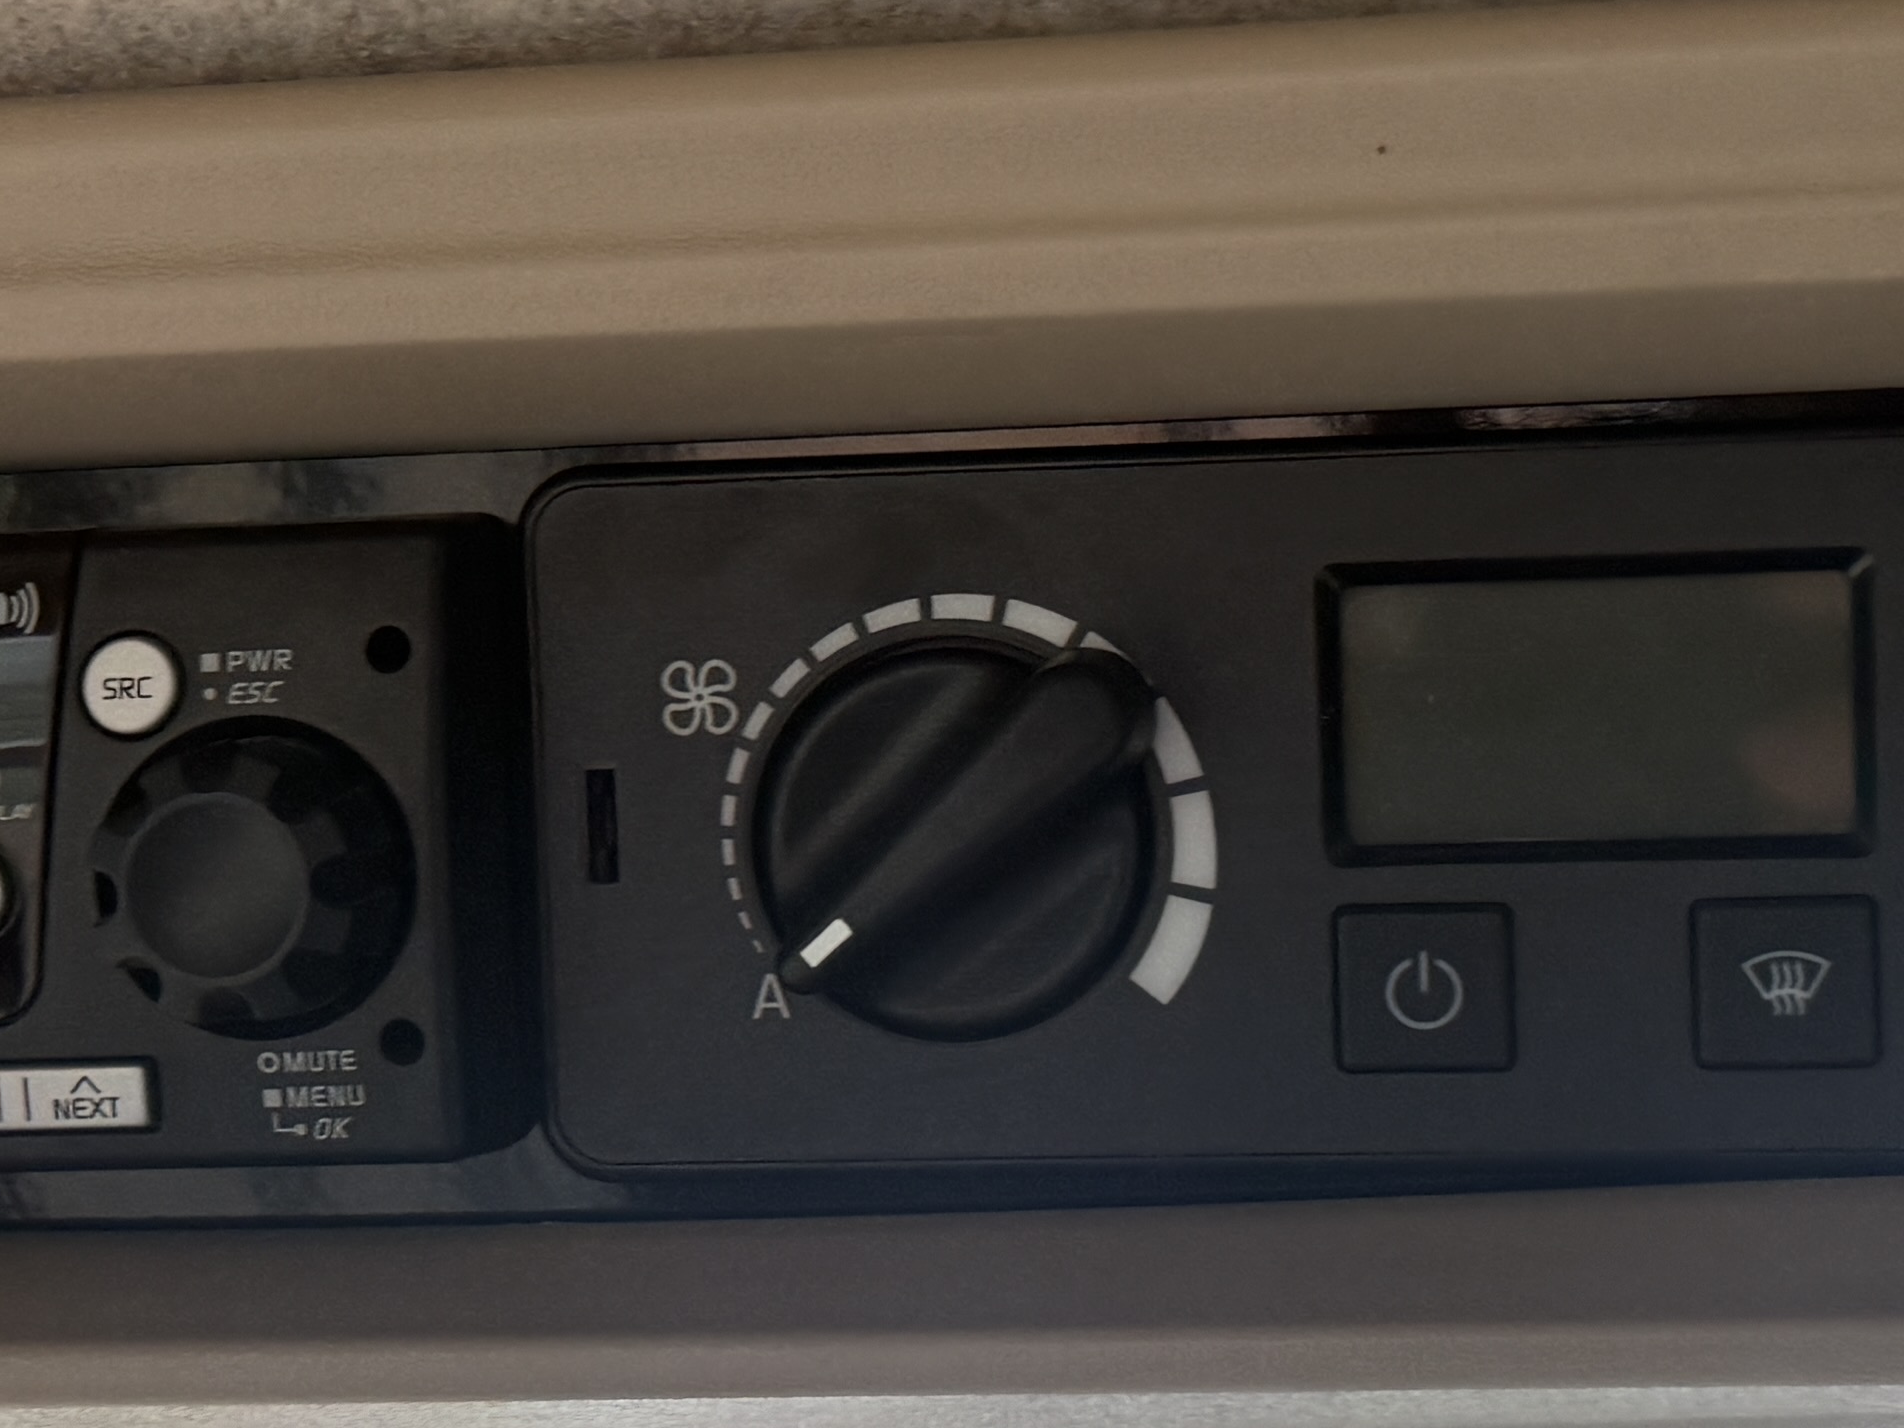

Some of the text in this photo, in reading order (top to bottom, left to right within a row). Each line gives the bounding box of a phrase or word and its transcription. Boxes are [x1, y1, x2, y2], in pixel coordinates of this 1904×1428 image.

[226, 648, 294, 673] PWR
[102, 676, 153, 700] SRC
[226, 680, 285, 705] ESC
[751, 972, 792, 1021] A
[281, 1049, 359, 1073] MUTE
[286, 1083, 367, 1108] MENU
[52, 1096, 121, 1121] NEXT
[312, 1116, 351, 1141] OK
